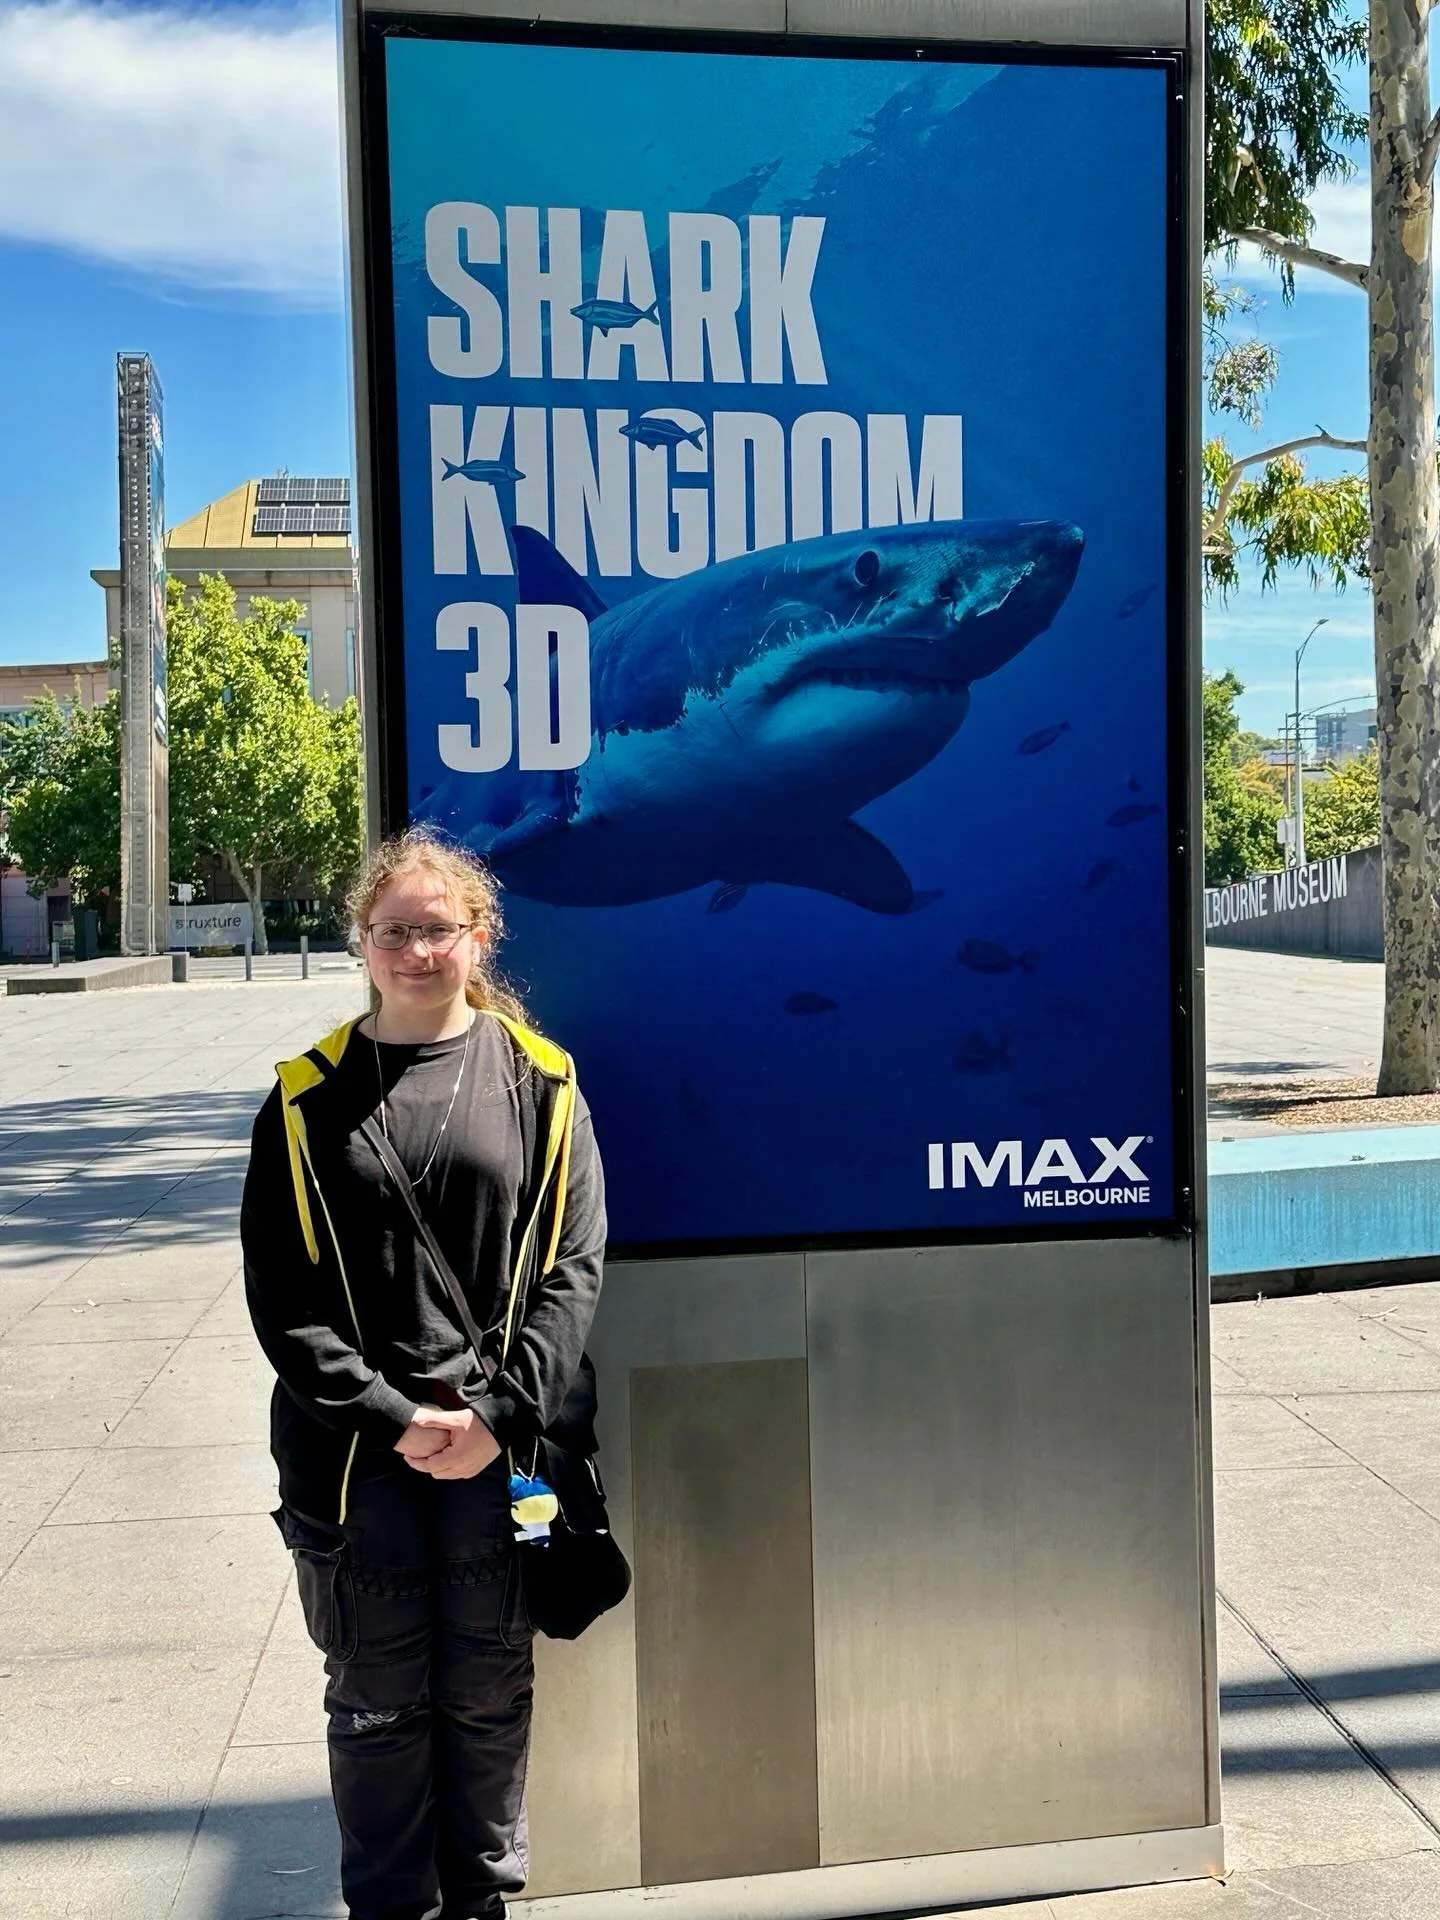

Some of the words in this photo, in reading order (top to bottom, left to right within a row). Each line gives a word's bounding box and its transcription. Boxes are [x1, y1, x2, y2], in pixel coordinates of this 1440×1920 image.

[425, 202, 828, 385] SHARK
[430, 404, 963, 579] KINGDOM
[436, 601, 592, 773] 3D
[175, 916, 242, 930] sruxture
[1205, 877, 1268, 928] LBOURNE
[1273, 855, 1347, 913] MUSEUM
[928, 1136, 1149, 1189] IMAX
[1024, 1187, 1150, 1207] MELBOURNE
